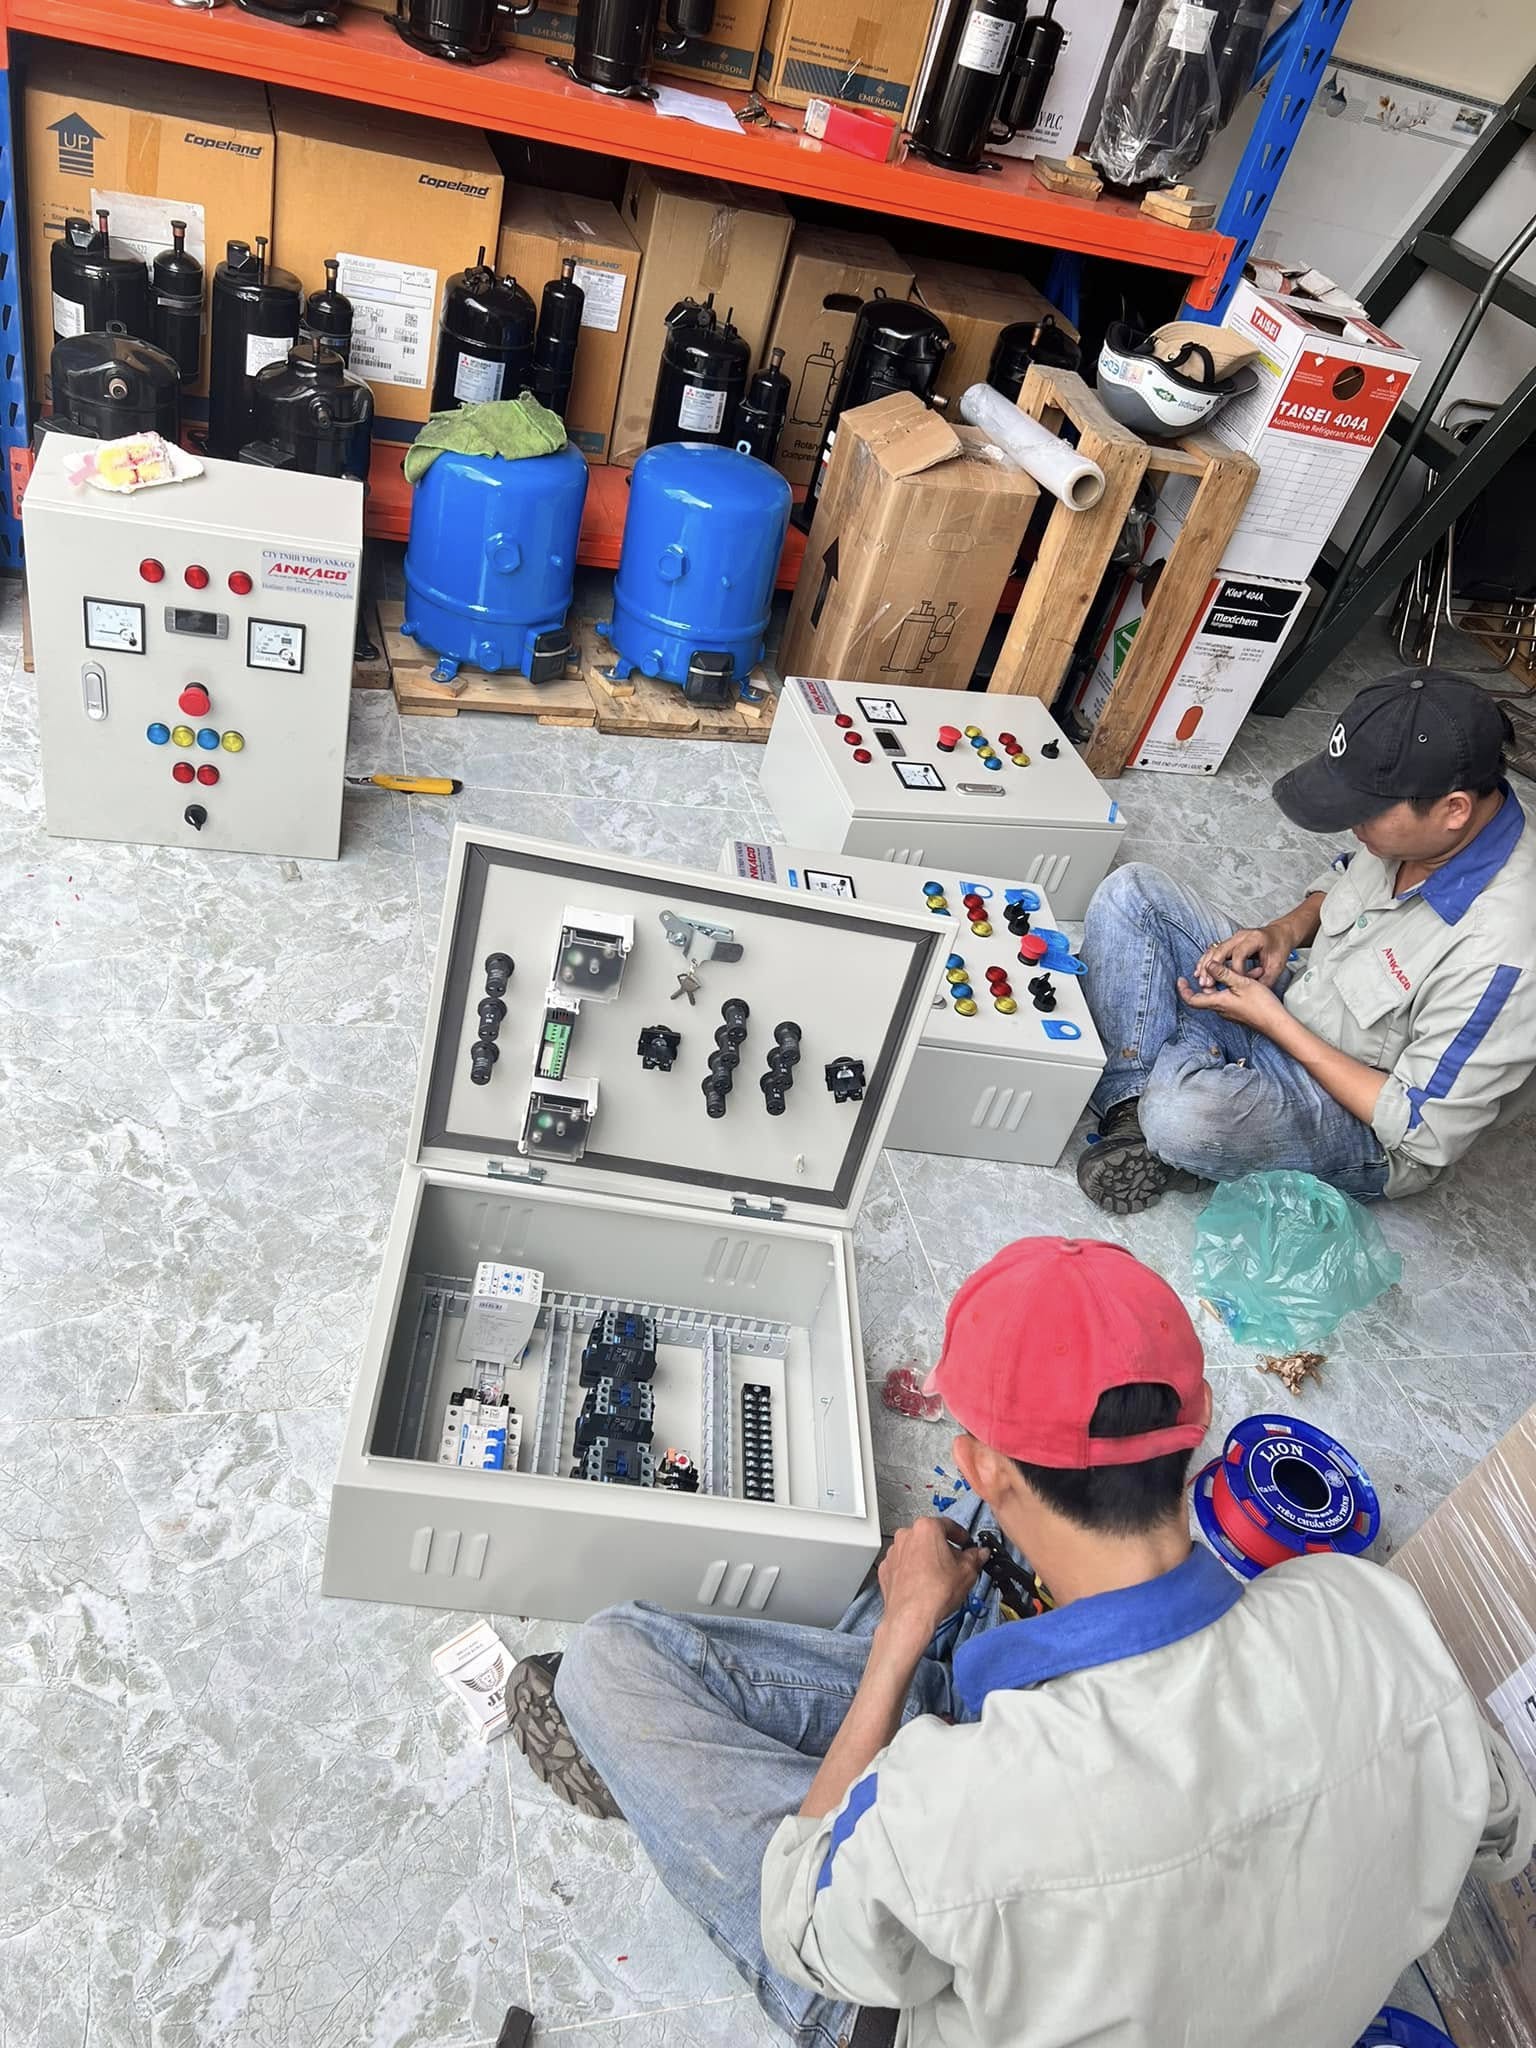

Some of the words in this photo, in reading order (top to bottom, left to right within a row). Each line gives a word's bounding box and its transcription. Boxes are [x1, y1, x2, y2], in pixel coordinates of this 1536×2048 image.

[702, 59, 743, 75] EMERSON
[858, 92, 898, 109] EMERSON
[64, 131, 90, 149] UP
[183, 132, 263, 156] Copeland
[418, 173, 489, 197] Copeland
[1252, 308, 1281, 340] TAISEI
[1279, 401, 1332, 424] TAISEI
[1334, 414, 1369, 431] 404A
[1272, 417, 1311, 432] Automotive
[1311, 424, 1345, 439] Refrigerant
[267, 562, 348, 581] ANKACO
[1246, 591, 1264, 602] 404A
[1382, 947, 1411, 991] ANKACO
[1259, 1442, 1303, 1463] LION
[488, 1687, 505, 1706] JE
